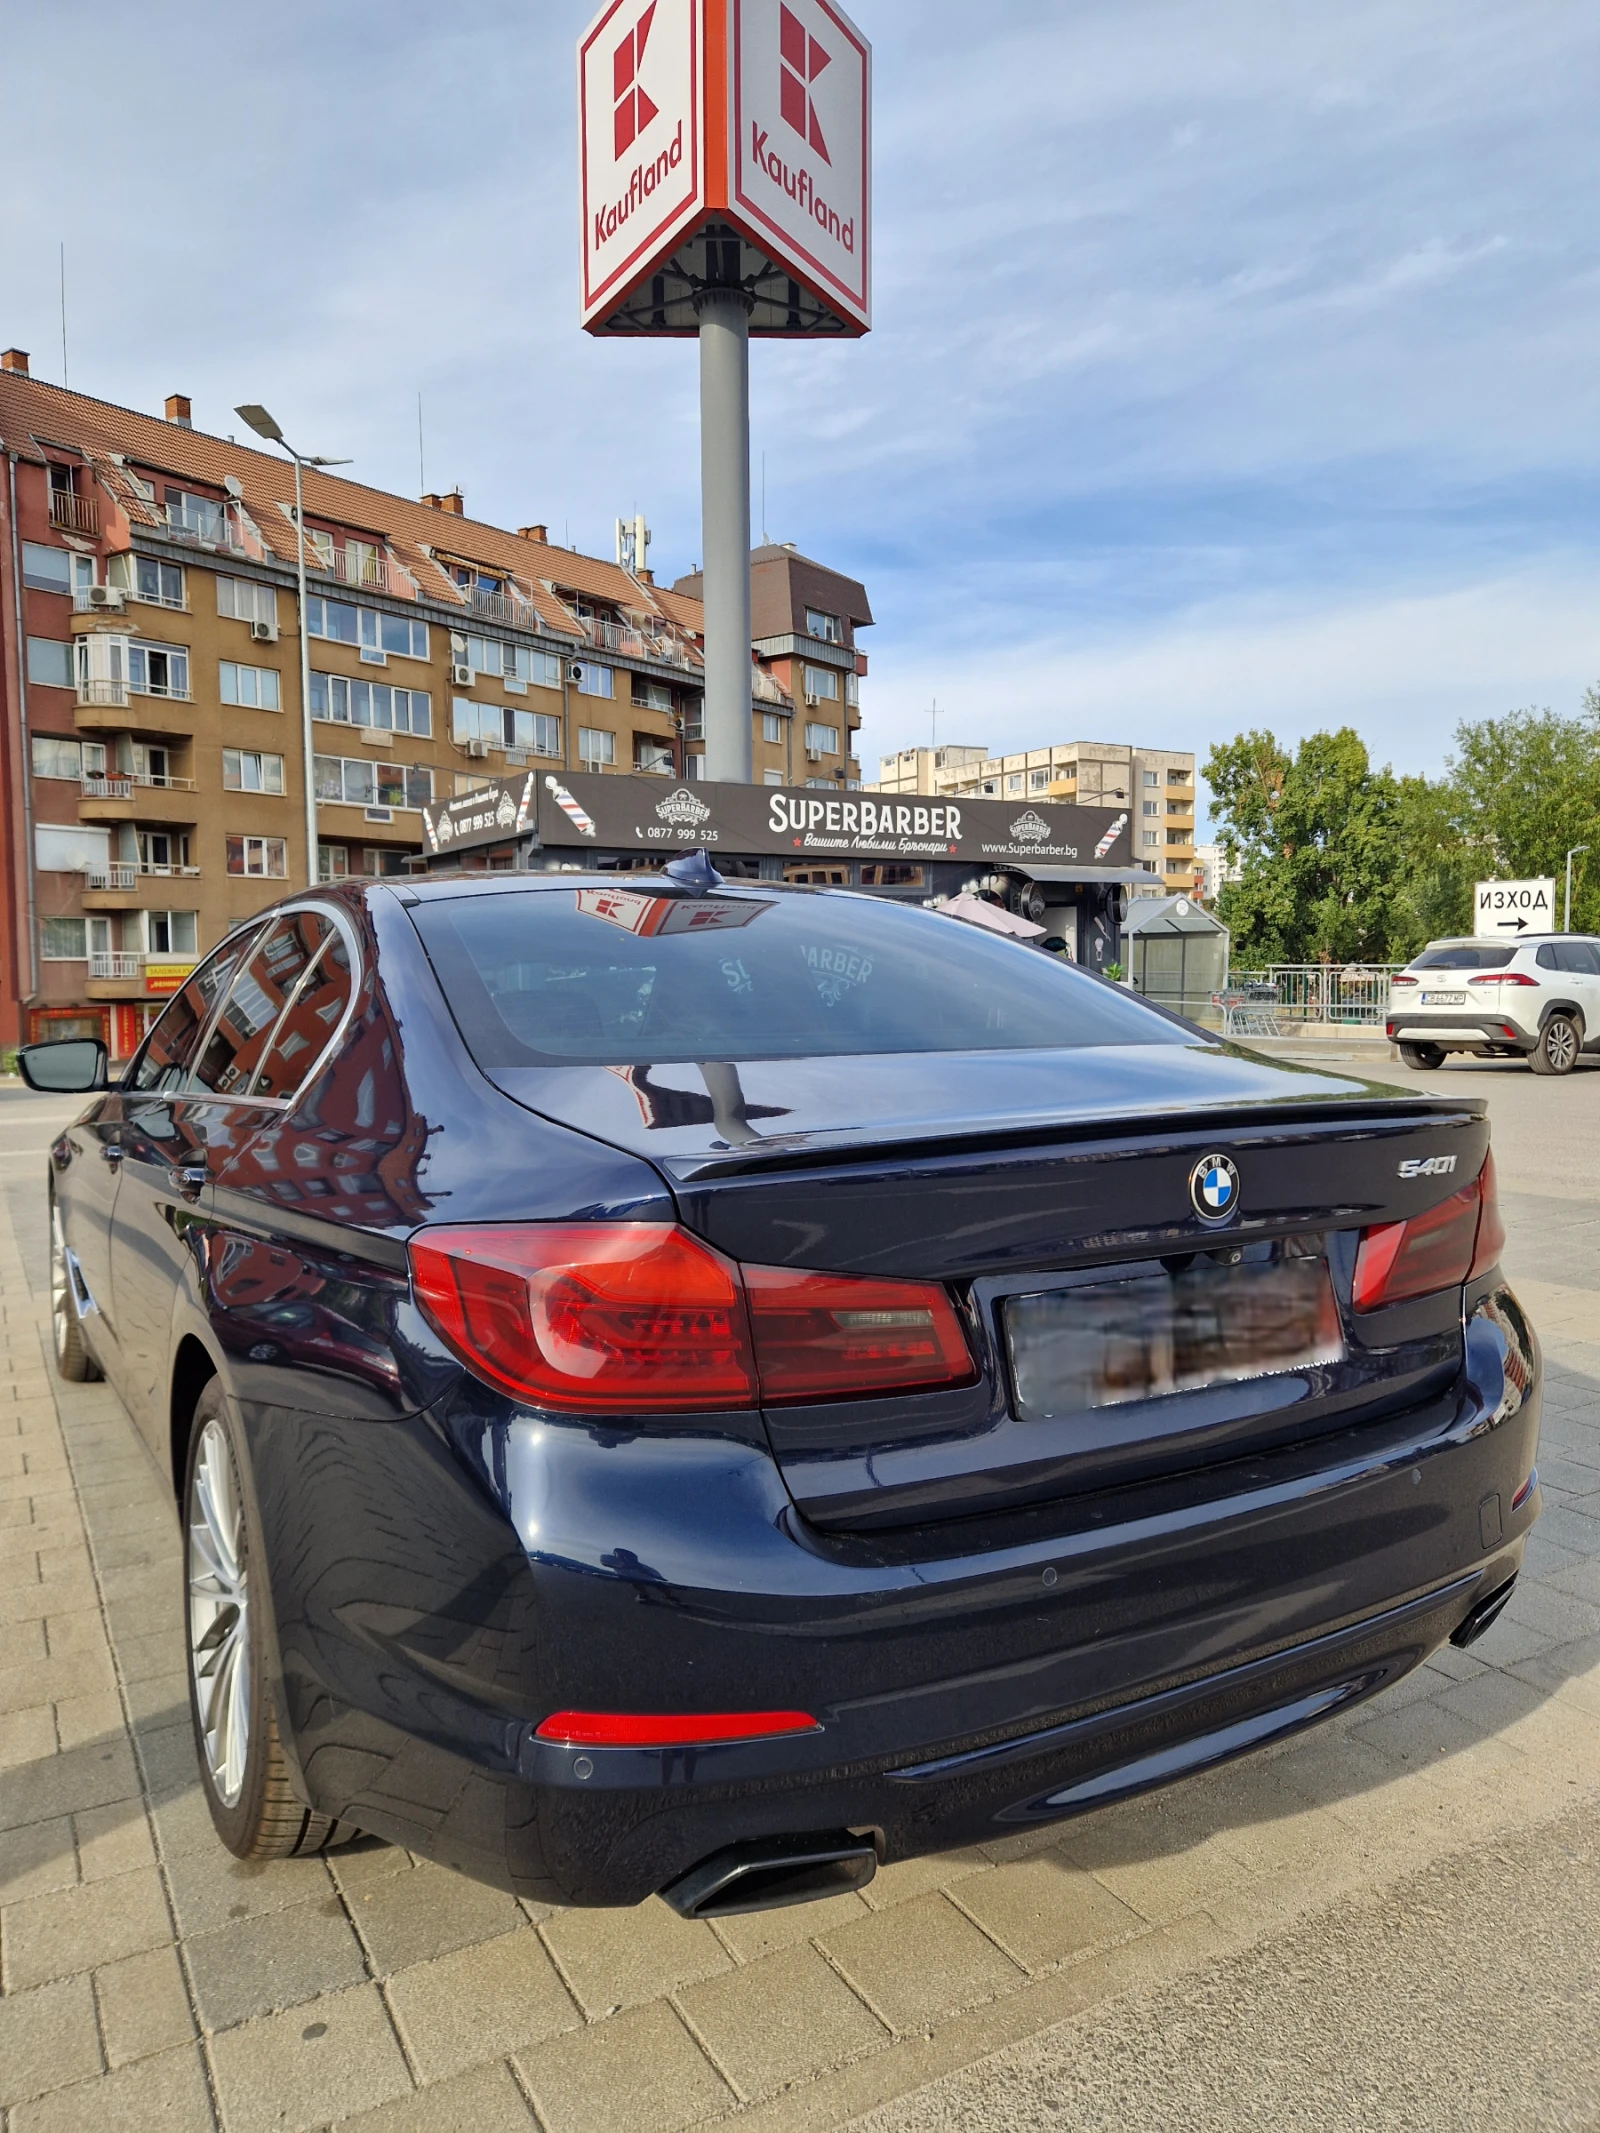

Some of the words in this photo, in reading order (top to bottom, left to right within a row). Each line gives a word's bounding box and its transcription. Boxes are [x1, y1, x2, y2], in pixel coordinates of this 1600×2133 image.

[595, 119, 682, 250] Kaufland
[752, 119, 853, 254] Kaufland
[473, 814, 483, 830] 999
[484, 810, 495, 828] 525
[655, 802, 711, 820] SUPERBARBER
[769, 793, 963, 840] SUPERBARBER
[647, 827, 673, 839] 0877
[677, 828, 696, 840] 999
[700, 829, 719, 841] 525
[804, 832, 849, 849] Вашите
[850, 835, 897, 850] Любими
[981, 842, 1078, 858] www.Superbarber.bg
[1480, 889, 1548, 910] ИЗХОД
[1197, 1156, 1236, 1179] BMW
